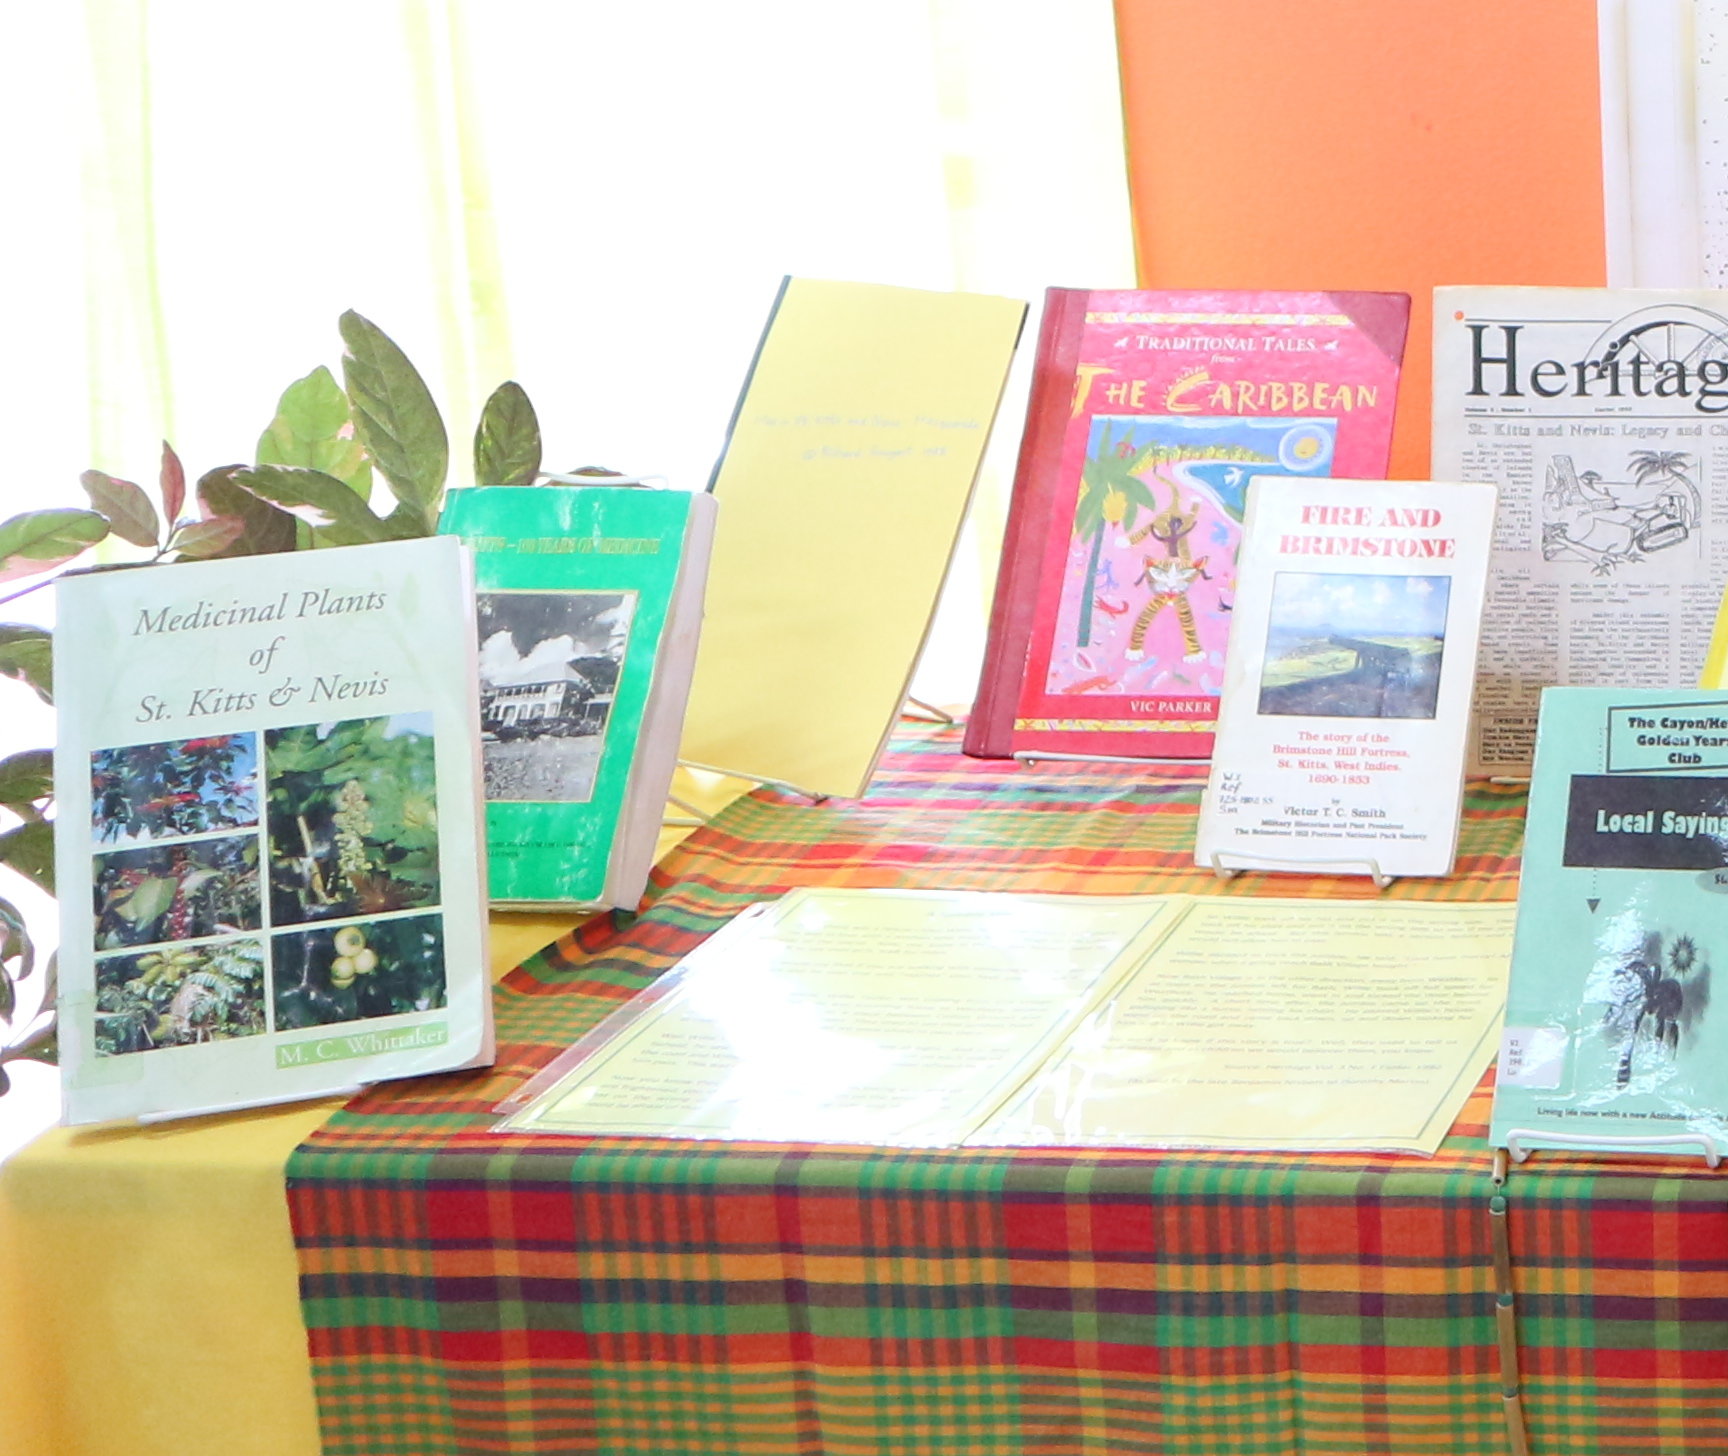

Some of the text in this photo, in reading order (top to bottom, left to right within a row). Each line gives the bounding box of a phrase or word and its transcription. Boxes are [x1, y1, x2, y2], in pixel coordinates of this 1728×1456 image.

[1136, 334, 1256, 351] TRADITIONAL
[1071, 363, 1377, 419] THE CARIBBEAN
[1468, 423, 1487, 435] St.
[1495, 424, 1530, 437] Kitts
[1537, 424, 1563, 436] and
[1570, 424, 1614, 436] Nevis:
[1622, 424, 1669, 439] Legacy
[1676, 424, 1702, 436] and
[1303, 506, 1441, 527] FIRE AND
[1281, 536, 1455, 558] BRIMSTONE
[133, 591, 386, 635] Medicinal Plants
[249, 636, 285, 674] of
[136, 671, 388, 722] St. Kitts & Nevis
[1131, 701, 1211, 712] VIC PARKER
[1628, 718, 1655, 728] The
[1273, 744, 1333, 755] Brimstone
[1337, 746, 1356, 756] Hill
[1637, 735, 1689, 746] Golden
[1668, 753, 1702, 764] Club
[1596, 810, 1654, 833] Local
[279, 1026, 445, 1065] M. C. Whittaker
